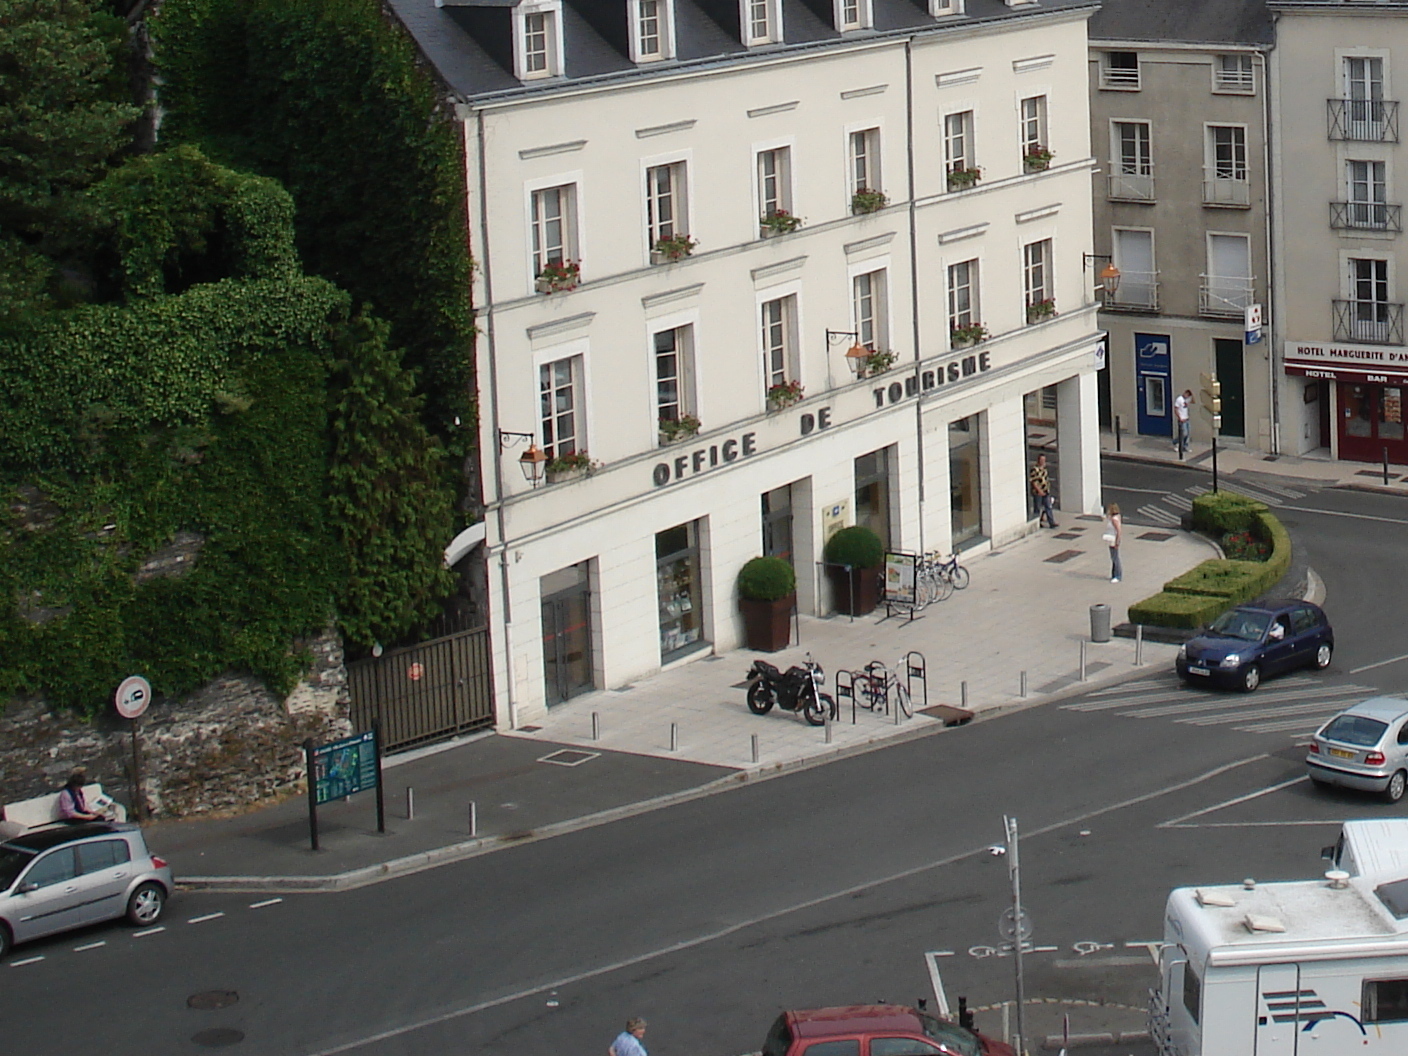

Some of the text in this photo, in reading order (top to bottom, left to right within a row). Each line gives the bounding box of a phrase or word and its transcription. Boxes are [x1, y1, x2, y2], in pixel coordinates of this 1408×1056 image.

[1297, 346, 1325, 357] HOTEL
[1330, 348, 1384, 361] MARGUERITE
[1305, 369, 1388, 383] HOTEL BAR
[653, 350, 991, 487] OFFICE DE TOURISME
